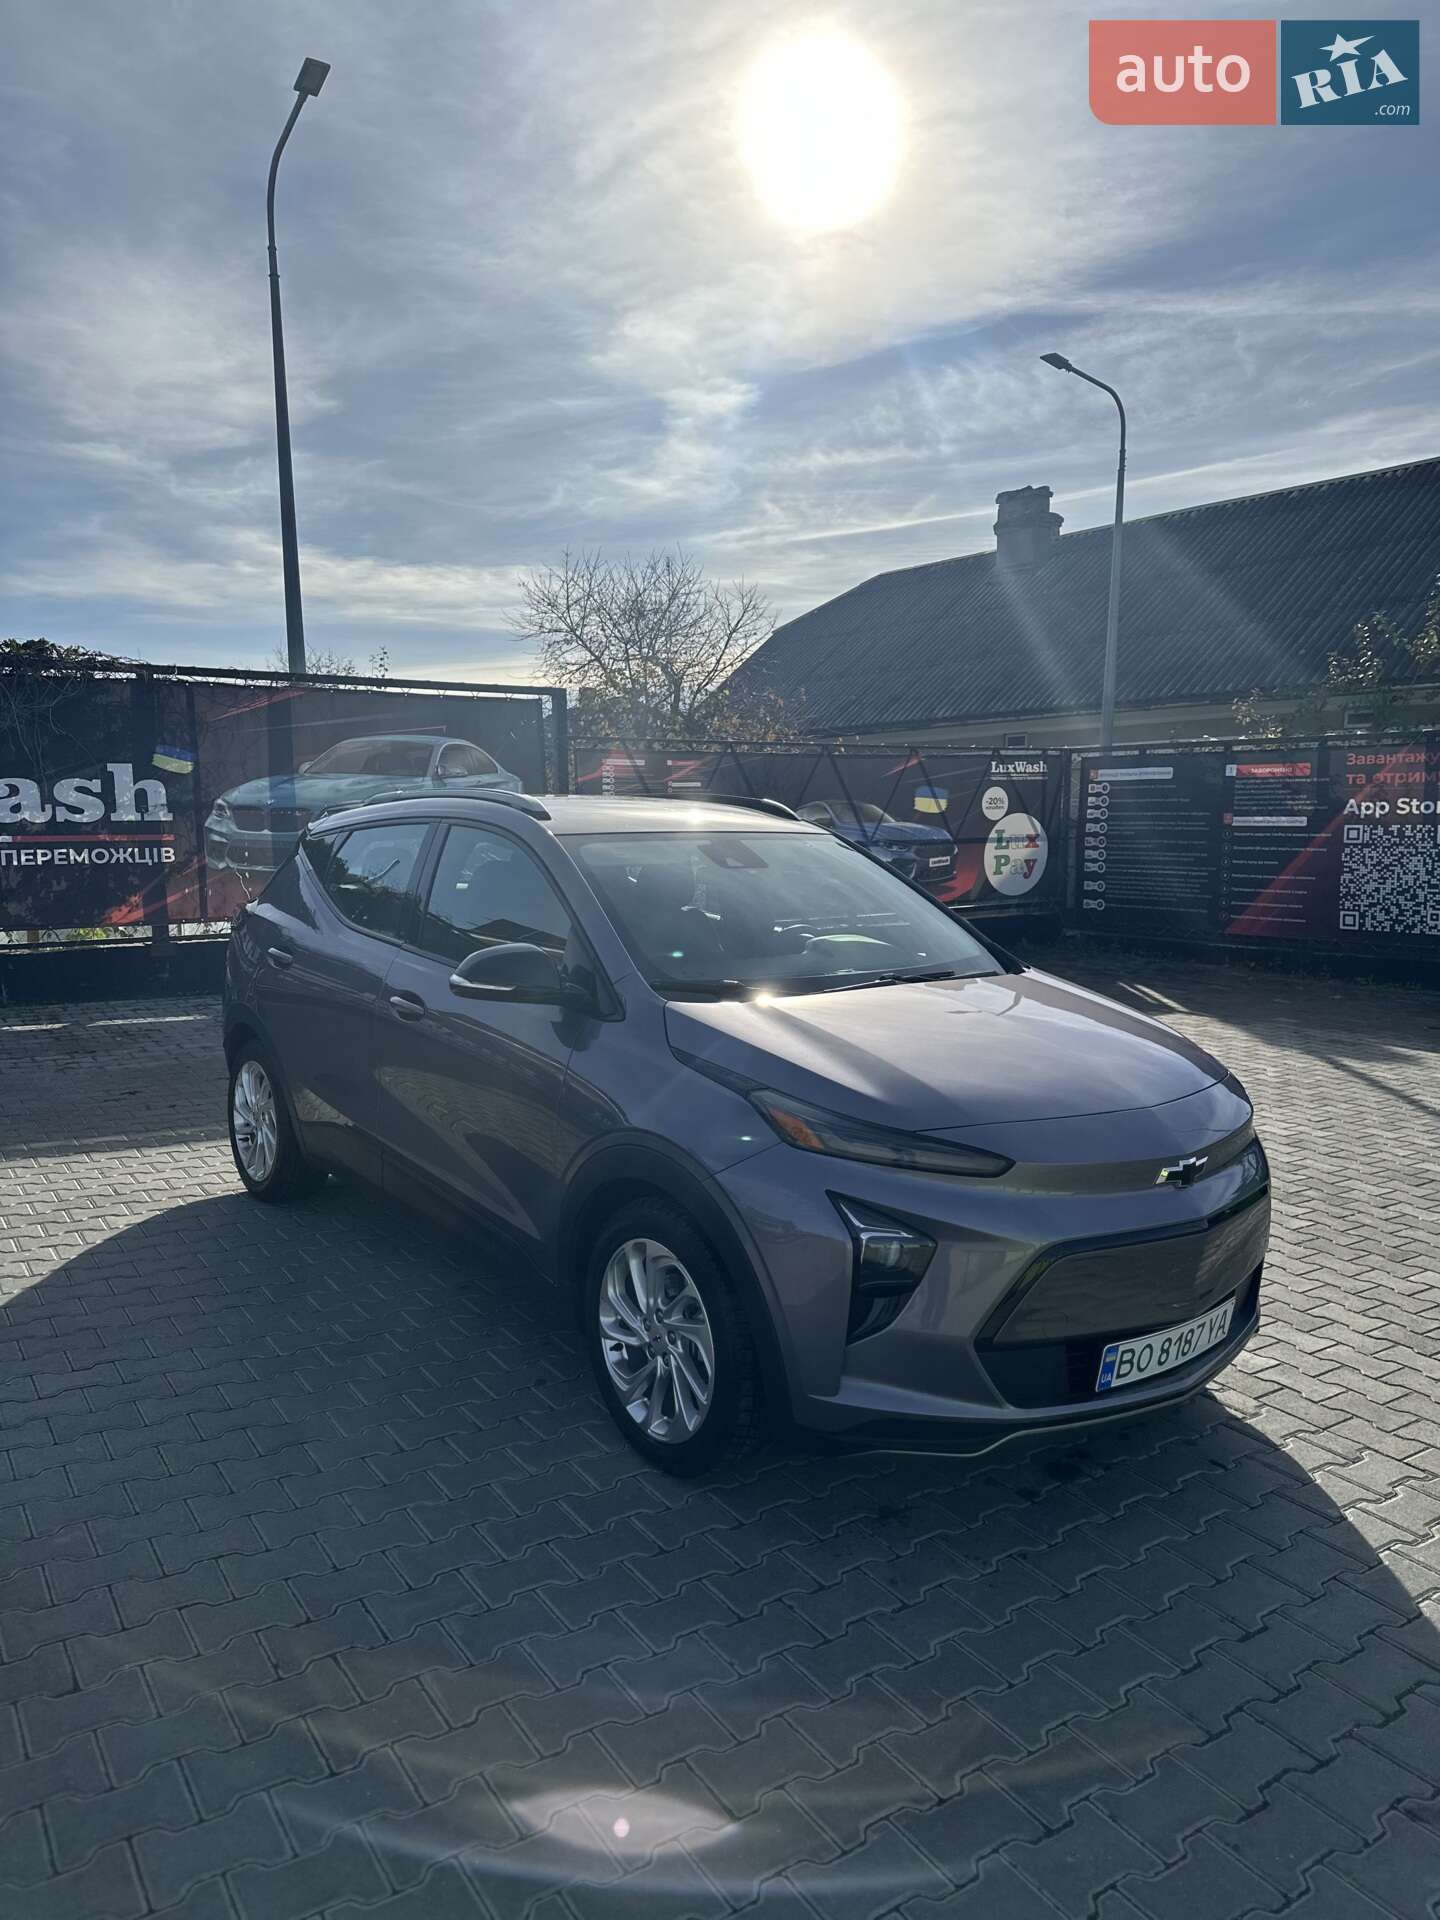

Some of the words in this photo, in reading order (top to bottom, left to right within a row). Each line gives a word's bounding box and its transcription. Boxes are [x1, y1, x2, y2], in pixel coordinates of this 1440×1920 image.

[990, 761, 1048, 773] LuxWash
[1346, 773, 1366, 785] та
[0, 763, 174, 824] ash
[1343, 798, 1390, 819] App
[994, 829, 1040, 850] Lux
[1, 847, 176, 866] ПЕРЕМОЖЦІВ
[993, 854, 1038, 879] Pay
[1115, 1343, 1153, 1380] BO
[1157, 1324, 1206, 1367] 8187
[1207, 1309, 1229, 1344] YA
[1101, 1374, 1112, 1383] UA
